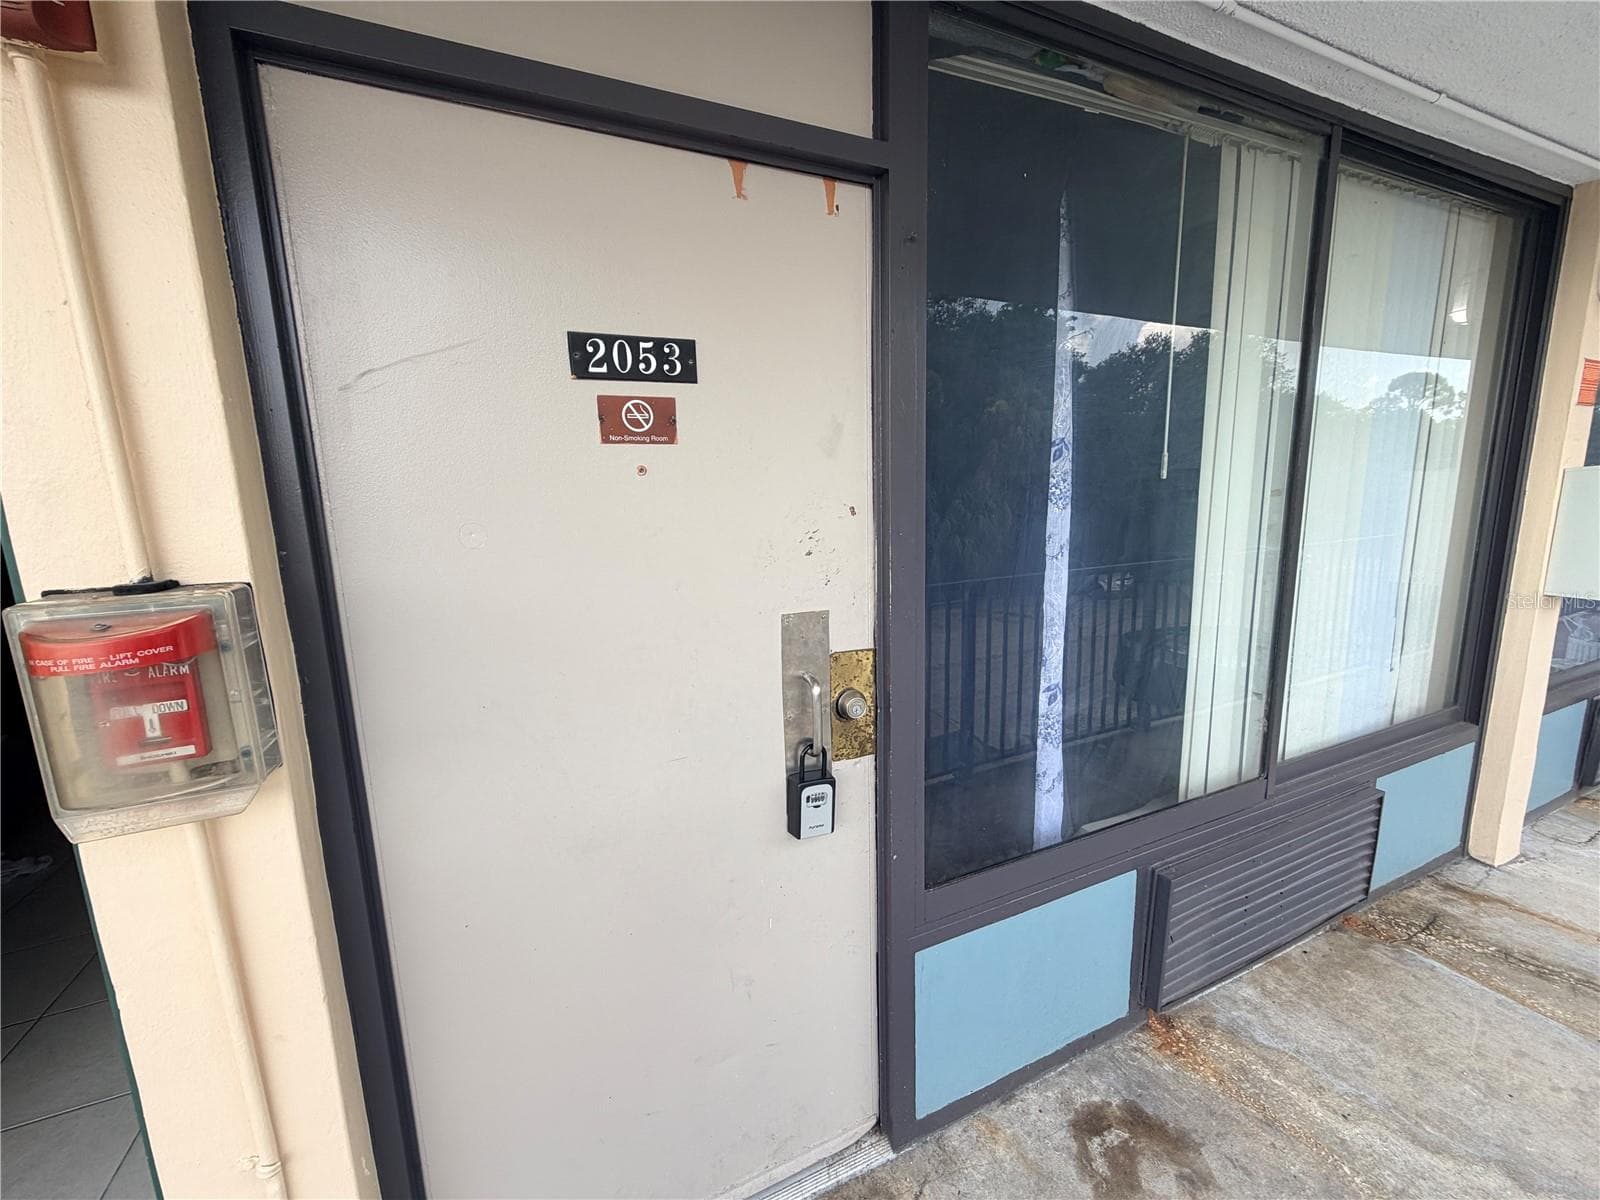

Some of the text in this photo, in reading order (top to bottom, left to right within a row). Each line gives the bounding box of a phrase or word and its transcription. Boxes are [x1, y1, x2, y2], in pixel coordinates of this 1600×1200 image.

[586, 338, 682, 376] 2053
[609, 434, 650, 443] Non-Smoking
[72, 657, 94, 665] FIRE
[109, 652, 133, 662] LIFT
[136, 645, 174, 657] COVER
[73, 663, 96, 671] FIRE
[100, 657, 140, 669] ALARM
[148, 665, 190, 678] ALARM
[152, 701, 184, 714] DOWN
